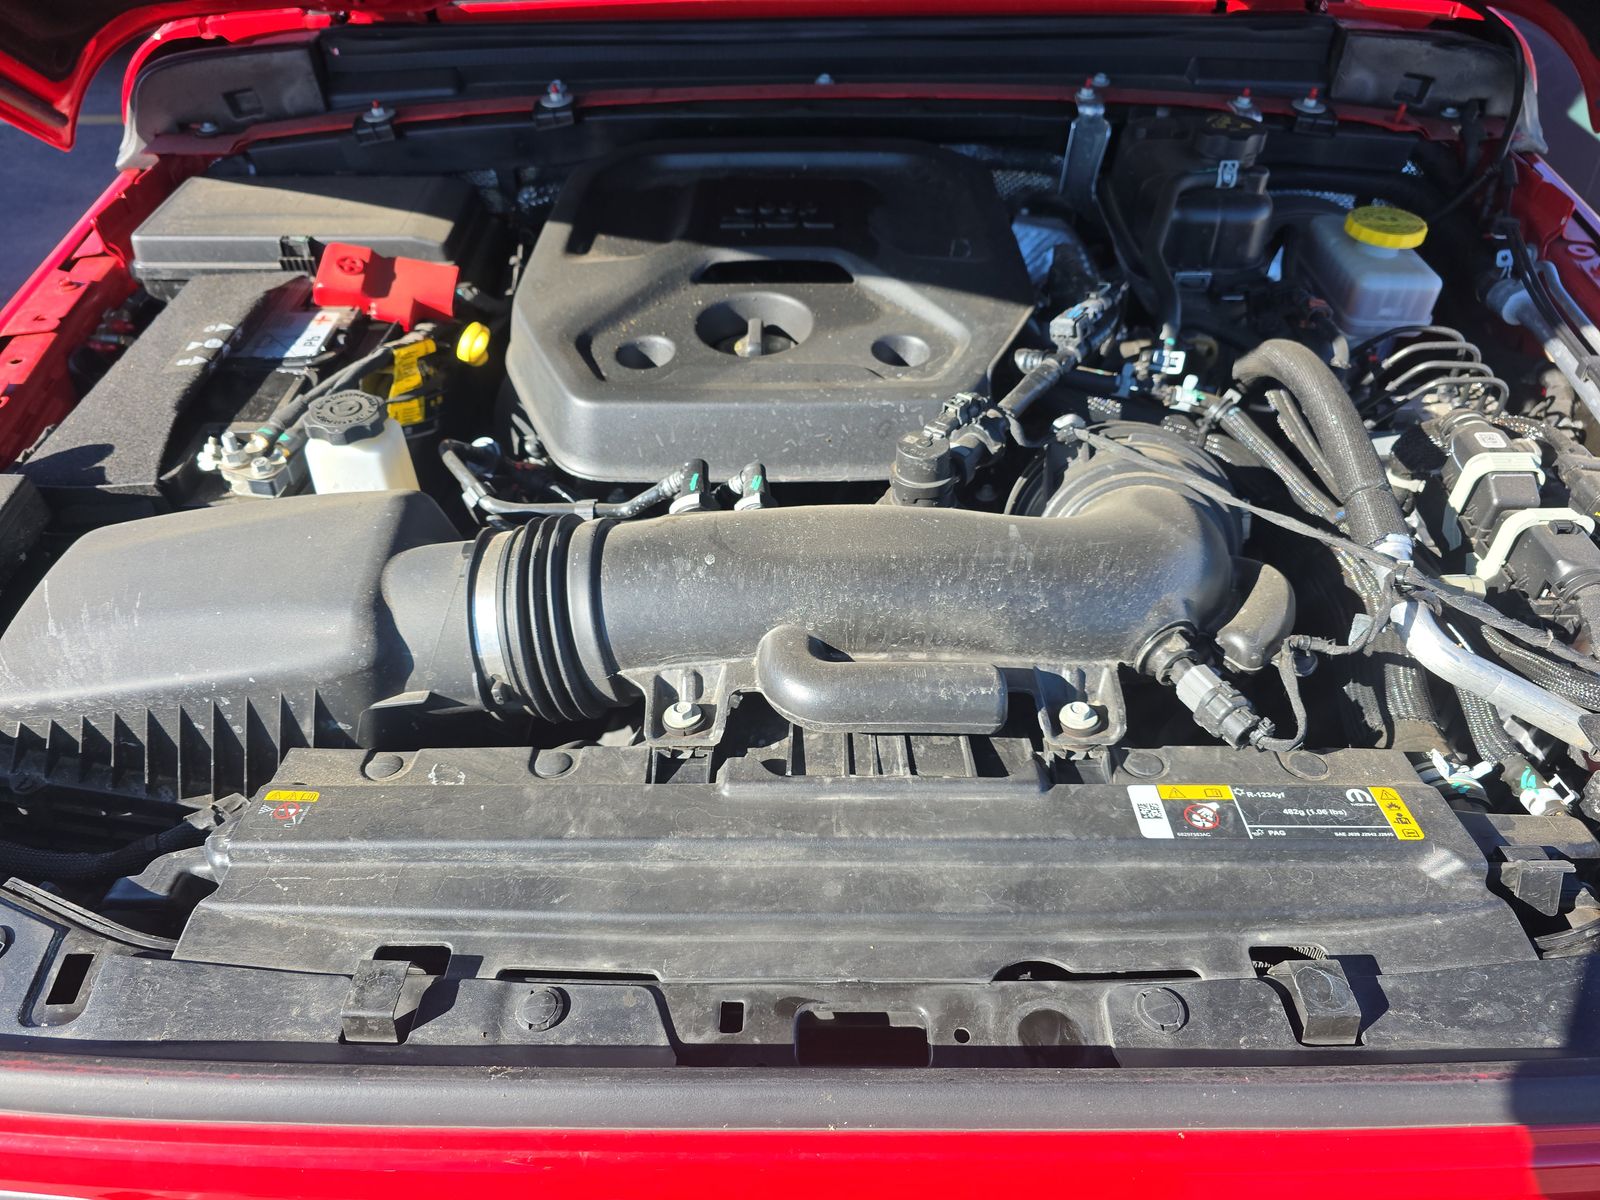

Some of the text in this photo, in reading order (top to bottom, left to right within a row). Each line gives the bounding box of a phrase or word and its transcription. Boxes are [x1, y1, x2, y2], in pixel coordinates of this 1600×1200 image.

[1282, 808, 1348, 816] 482g (1.06 lbs)
